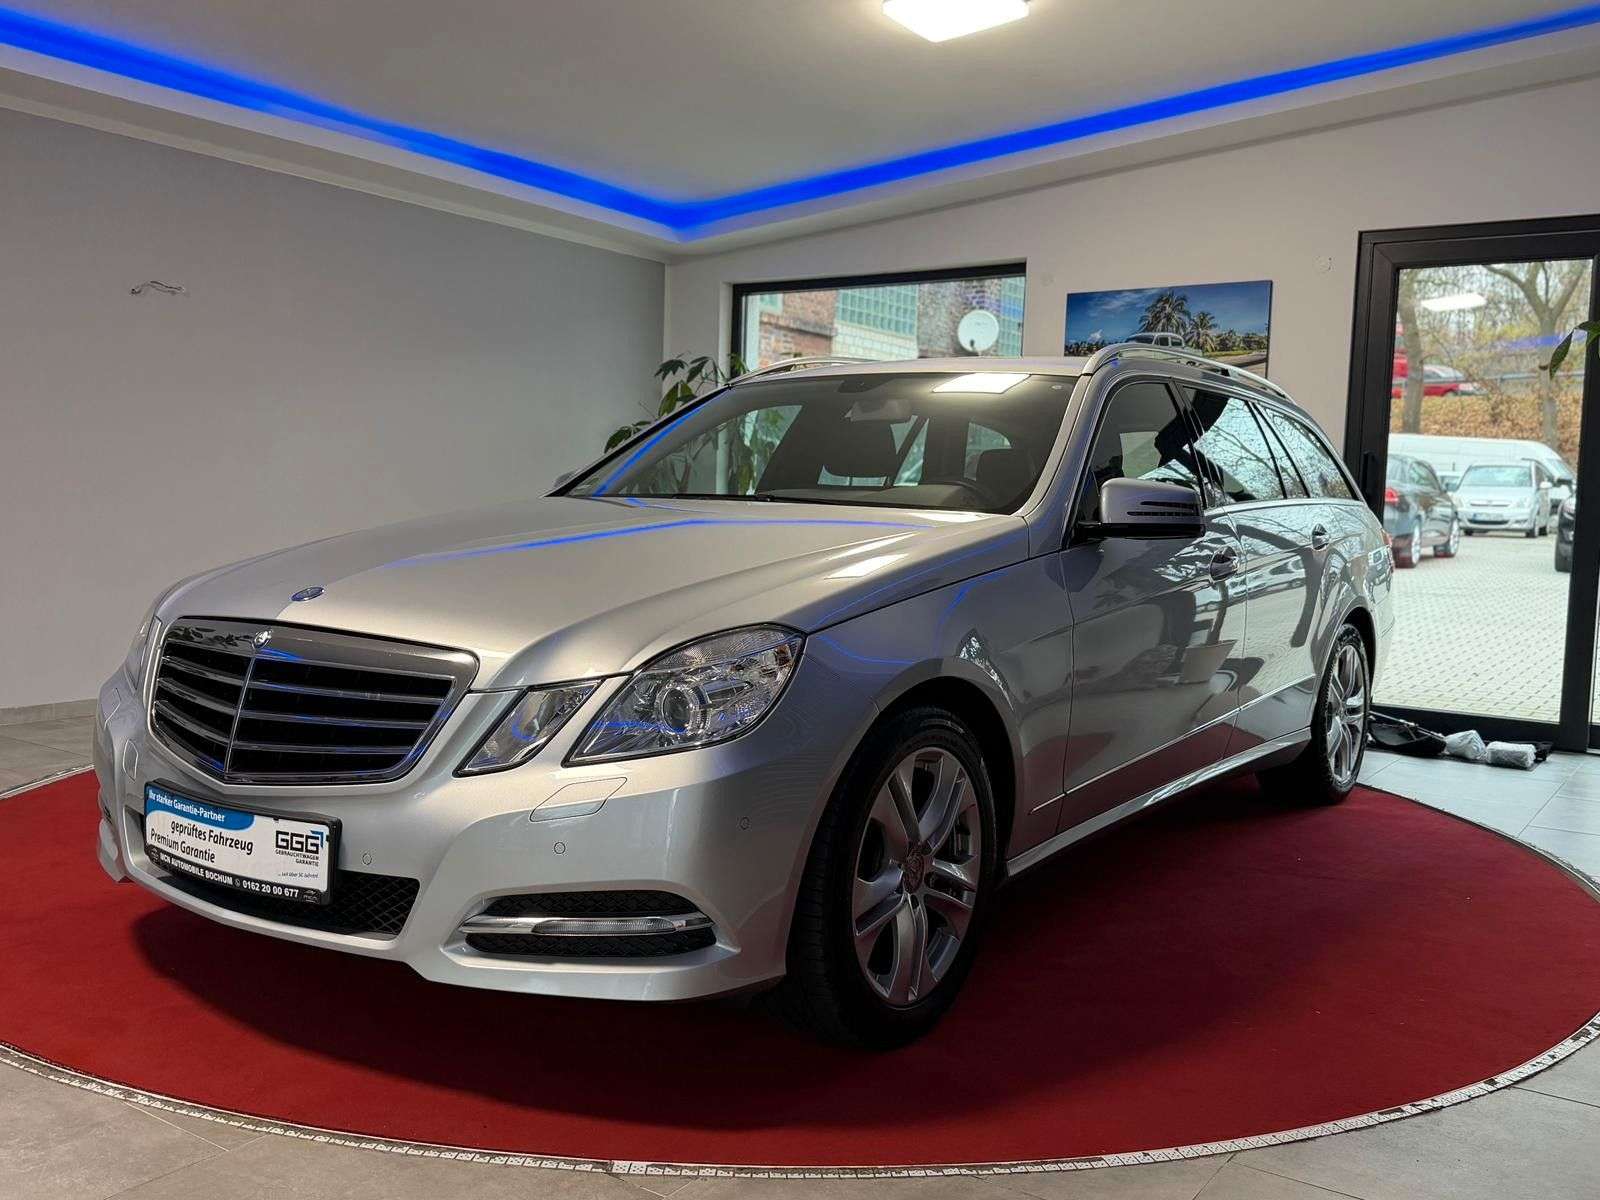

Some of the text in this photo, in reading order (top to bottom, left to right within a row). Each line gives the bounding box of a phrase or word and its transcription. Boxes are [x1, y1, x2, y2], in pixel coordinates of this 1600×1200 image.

[148, 789, 226, 822] Ihr starker Garantie-Partner
[150, 828, 179, 851] Premium
[180, 840, 216, 863] Garantie
[170, 820, 254, 855] geprüftes Fahrzeug
[275, 830, 320, 855] GGG
[274, 849, 320, 860] GEBRAUCHTWAGEN
[295, 858, 320, 867] GARANTIE
[171, 857, 205, 877] AUTOMOBILE
[205, 869, 234, 885] BOCHUM
[242, 879, 260, 892] 0162
[261, 883, 271, 894] 20
[272, 886, 283, 895] 00
[284, 888, 299, 898] 677
